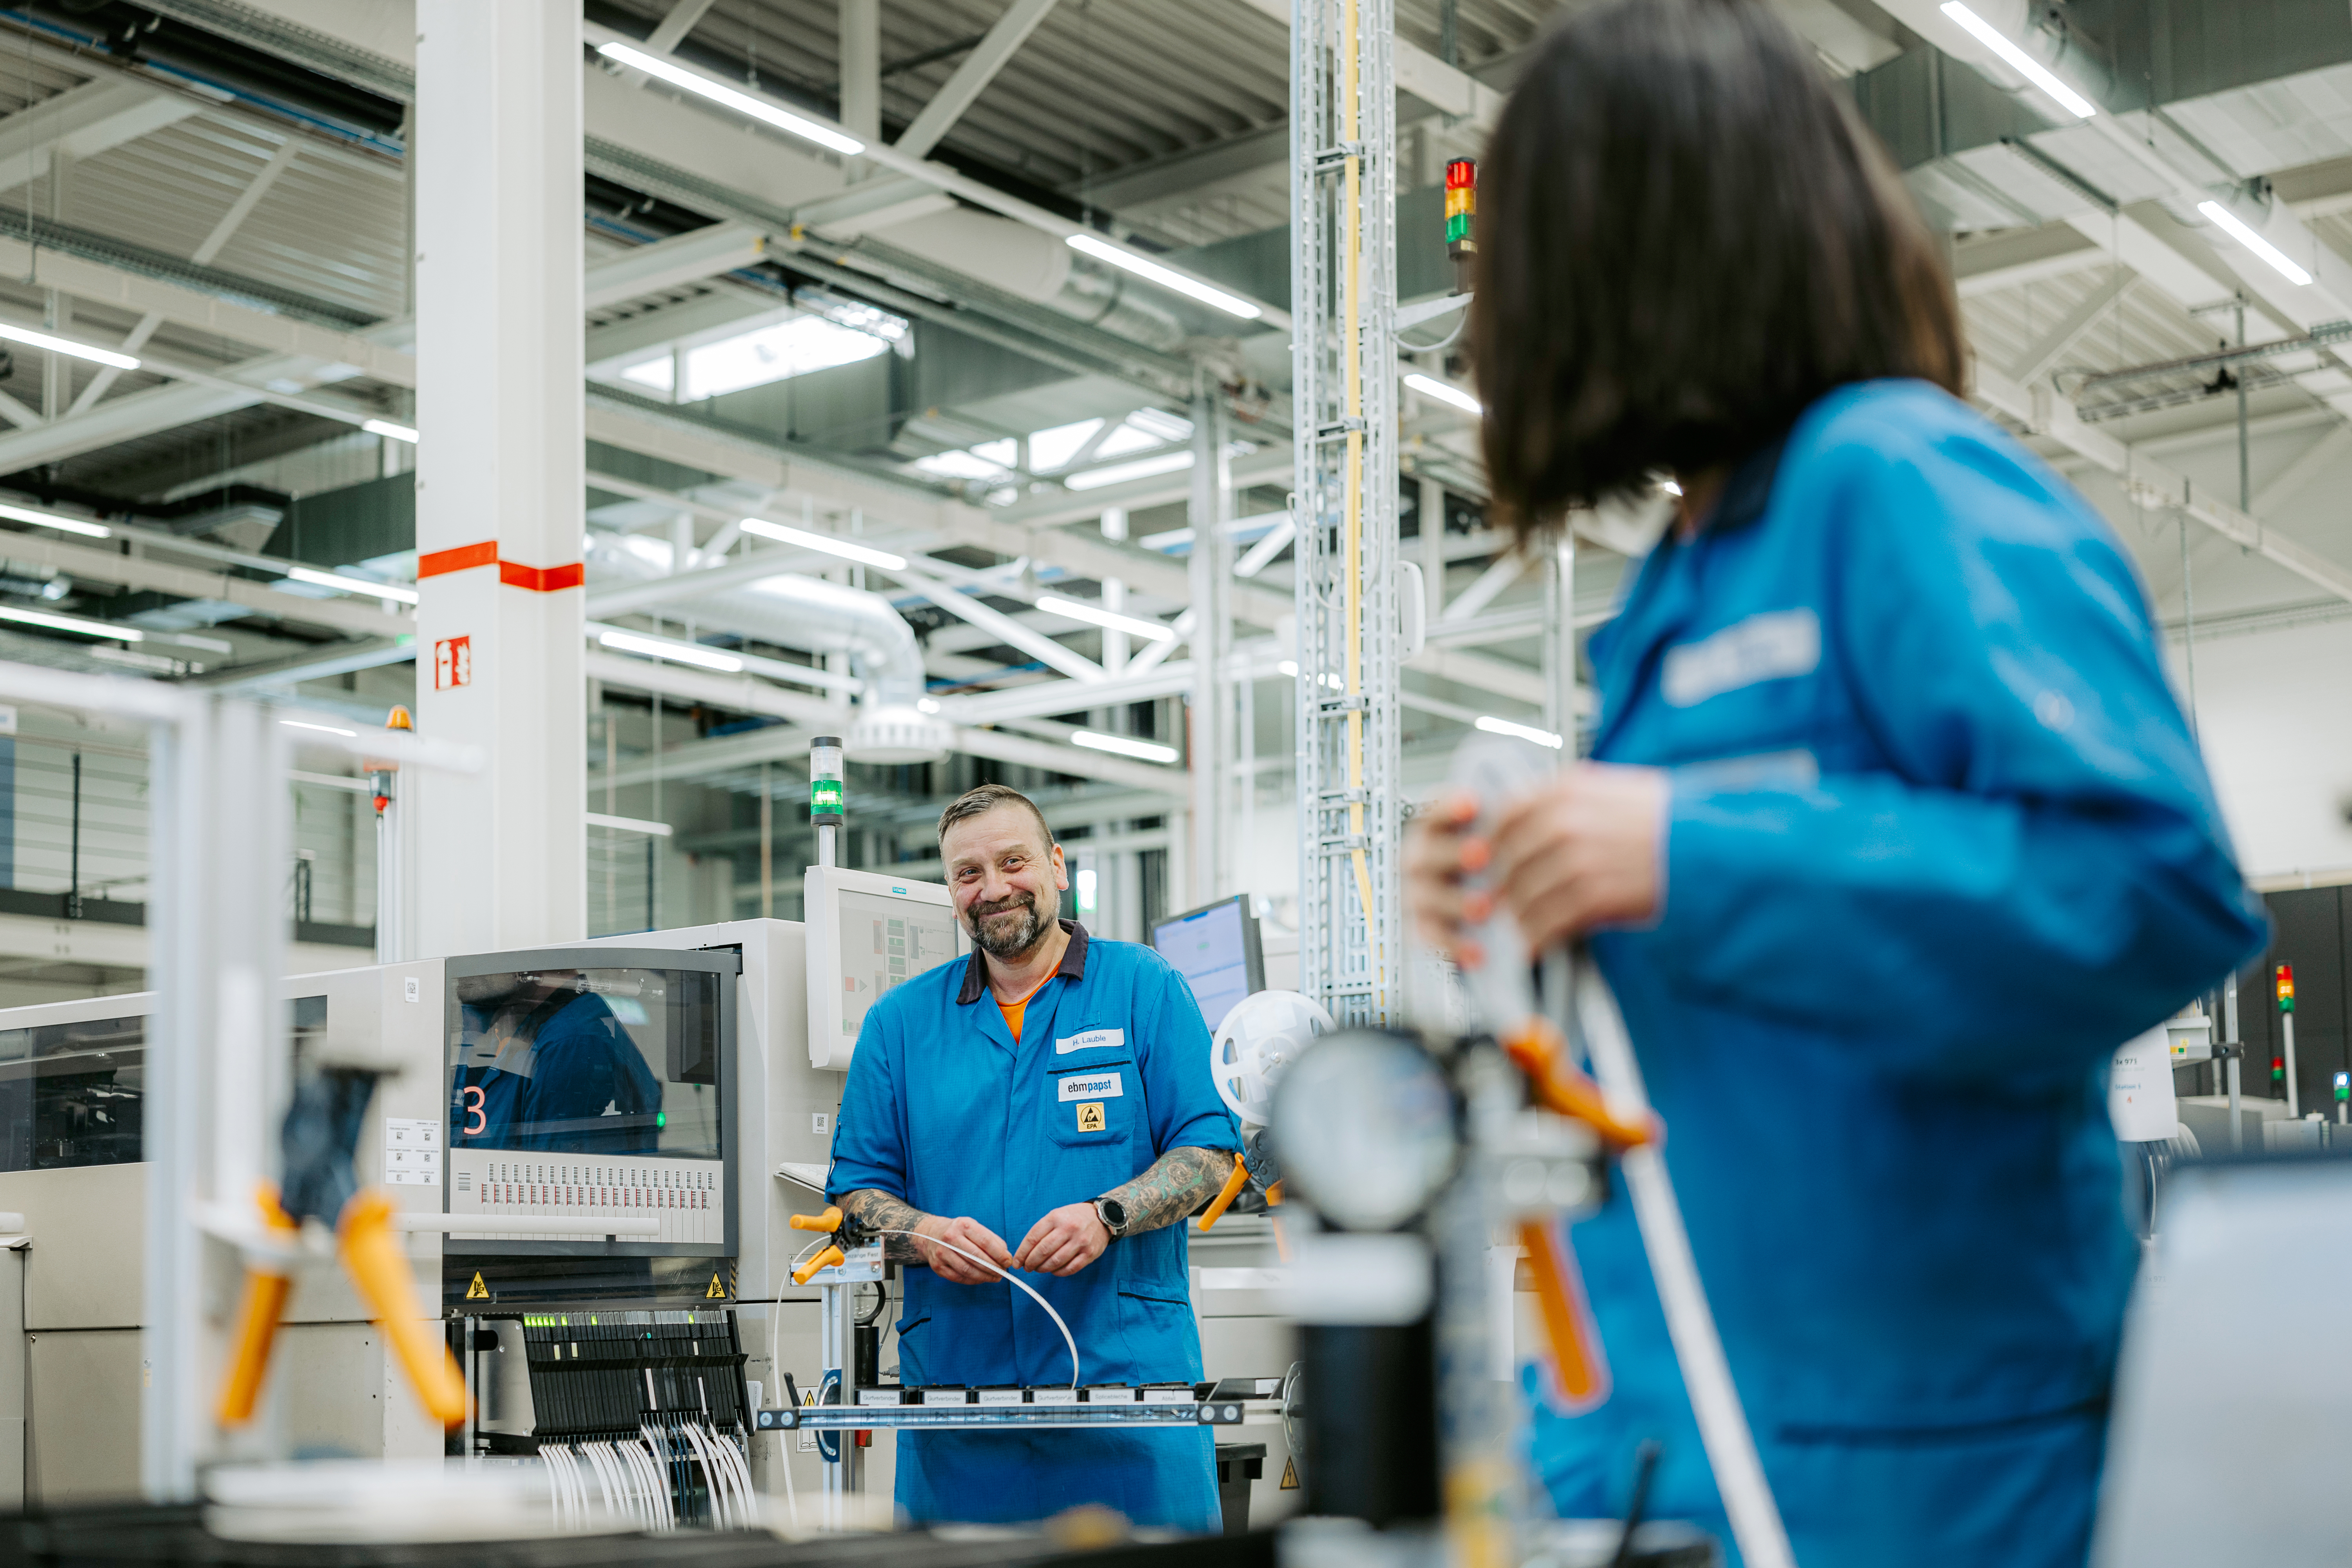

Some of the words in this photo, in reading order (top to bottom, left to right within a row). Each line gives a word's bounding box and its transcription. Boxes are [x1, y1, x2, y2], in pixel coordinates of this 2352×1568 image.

[1073, 1037, 1080, 1046] H.
[1082, 1035, 1106, 1043] Lauble
[1068, 1079, 1111, 1093] ebmpapst
[464, 1086, 486, 1135] 3
